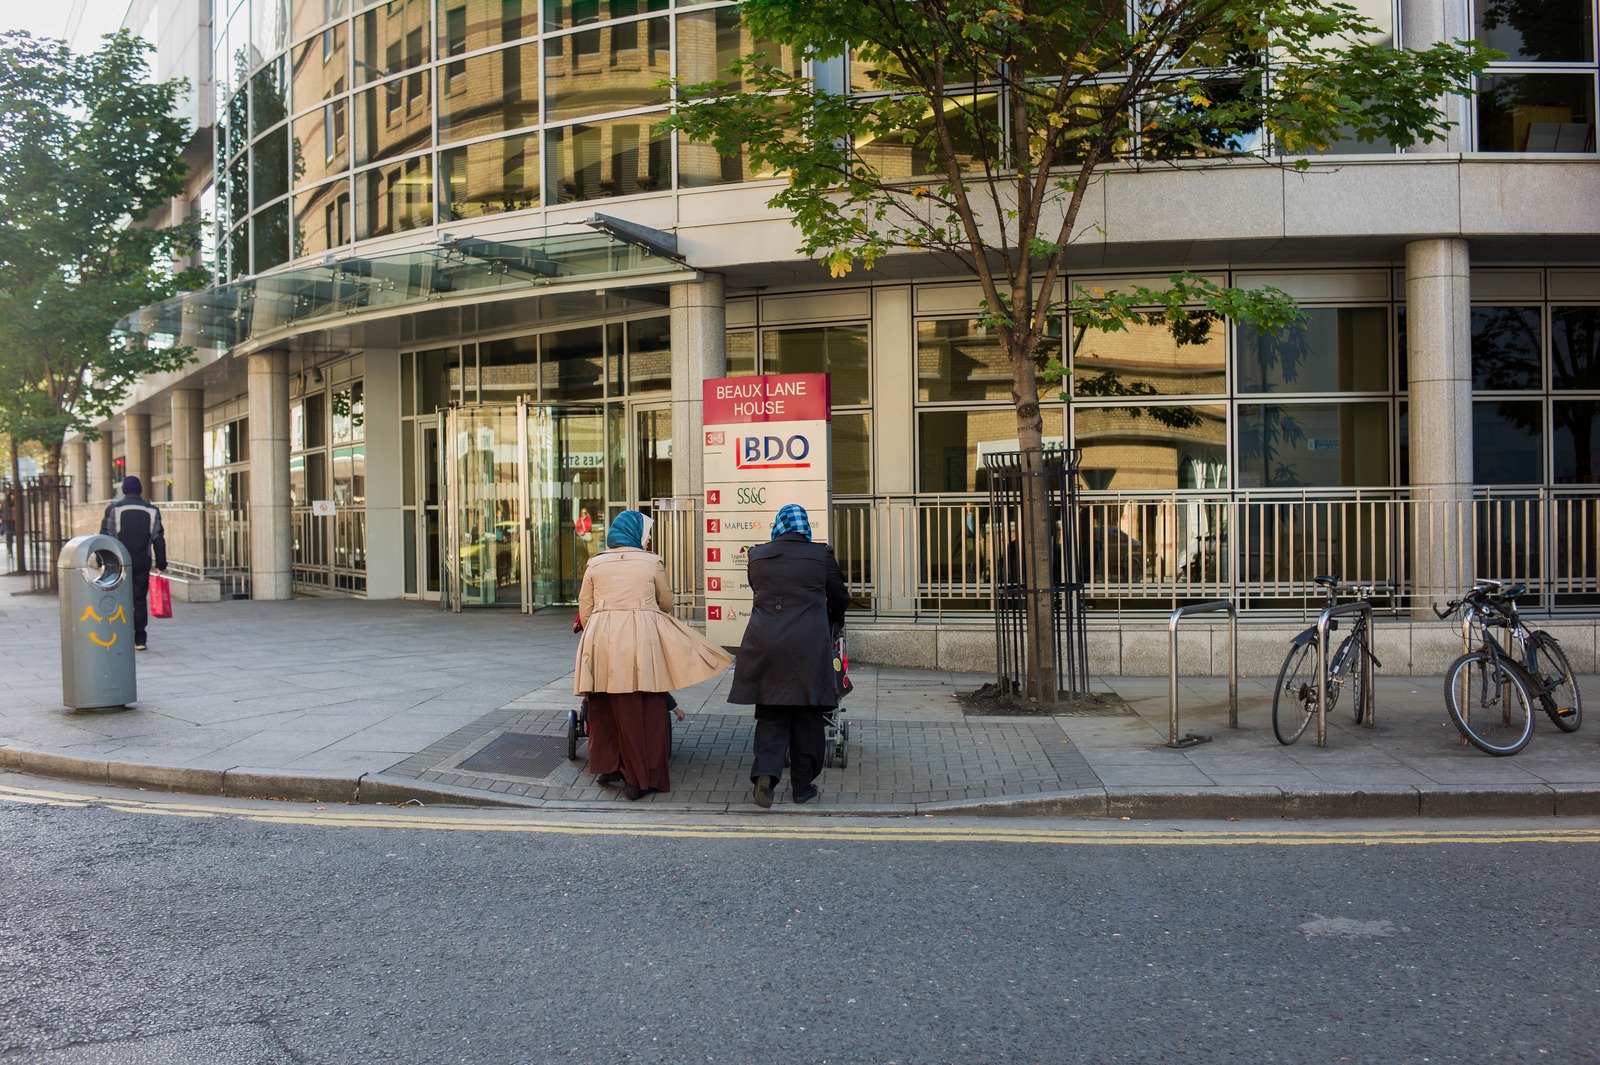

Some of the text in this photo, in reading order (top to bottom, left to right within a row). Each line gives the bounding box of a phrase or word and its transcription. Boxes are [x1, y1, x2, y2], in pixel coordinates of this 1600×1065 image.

[717, 382, 806, 399] BEAUX LANE
[734, 401, 785, 416] HOUSE
[707, 433, 723, 443] 3-5
[745, 435, 809, 461] BDO
[710, 492, 717, 502] 4
[737, 487, 766, 505] SS&C
[710, 521, 717, 530] 2
[712, 551, 716, 560] 1
[711, 579, 717, 588] 0
[710, 609, 719, 618] -1
